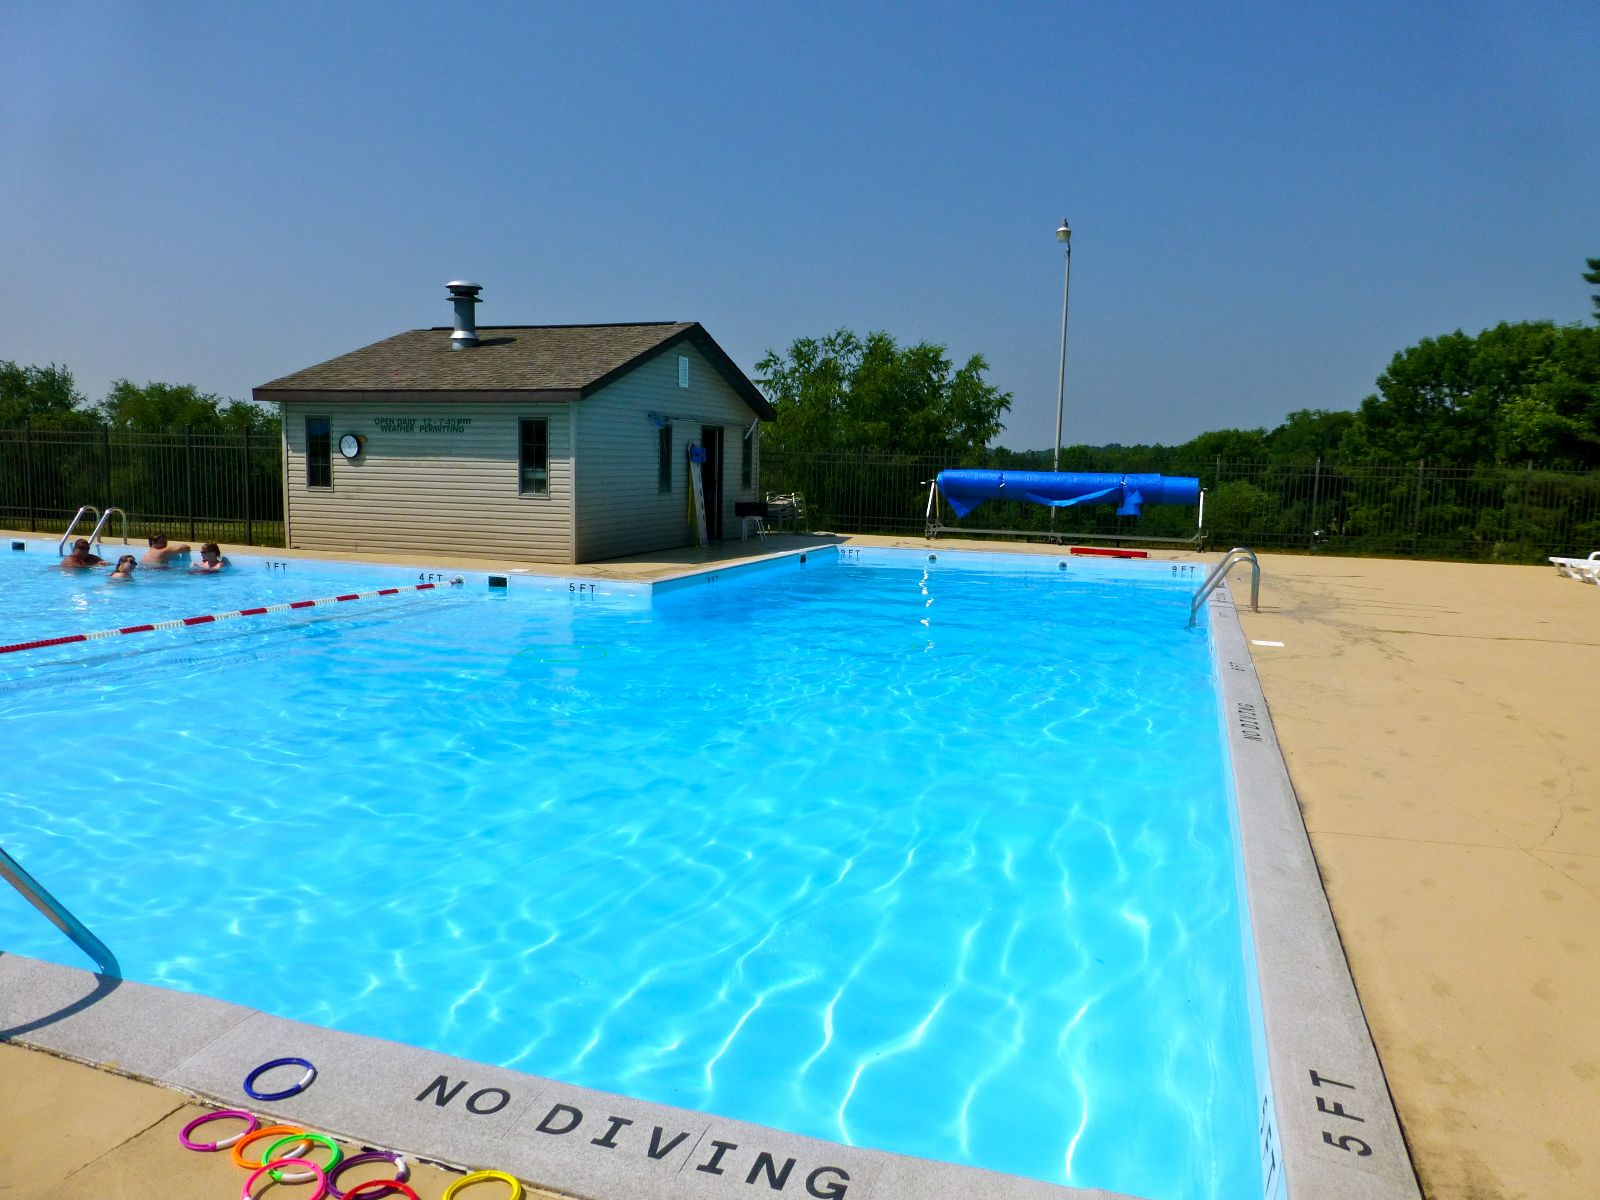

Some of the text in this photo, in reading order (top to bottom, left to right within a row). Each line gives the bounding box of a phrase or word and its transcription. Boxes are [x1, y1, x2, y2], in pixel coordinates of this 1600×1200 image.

[374, 417, 395, 425] OPEN
[397, 417, 416, 426] DAILY
[381, 424, 465, 433] WEATHER PERMITTING
[415, 1075, 851, 1200] NO DIVING
